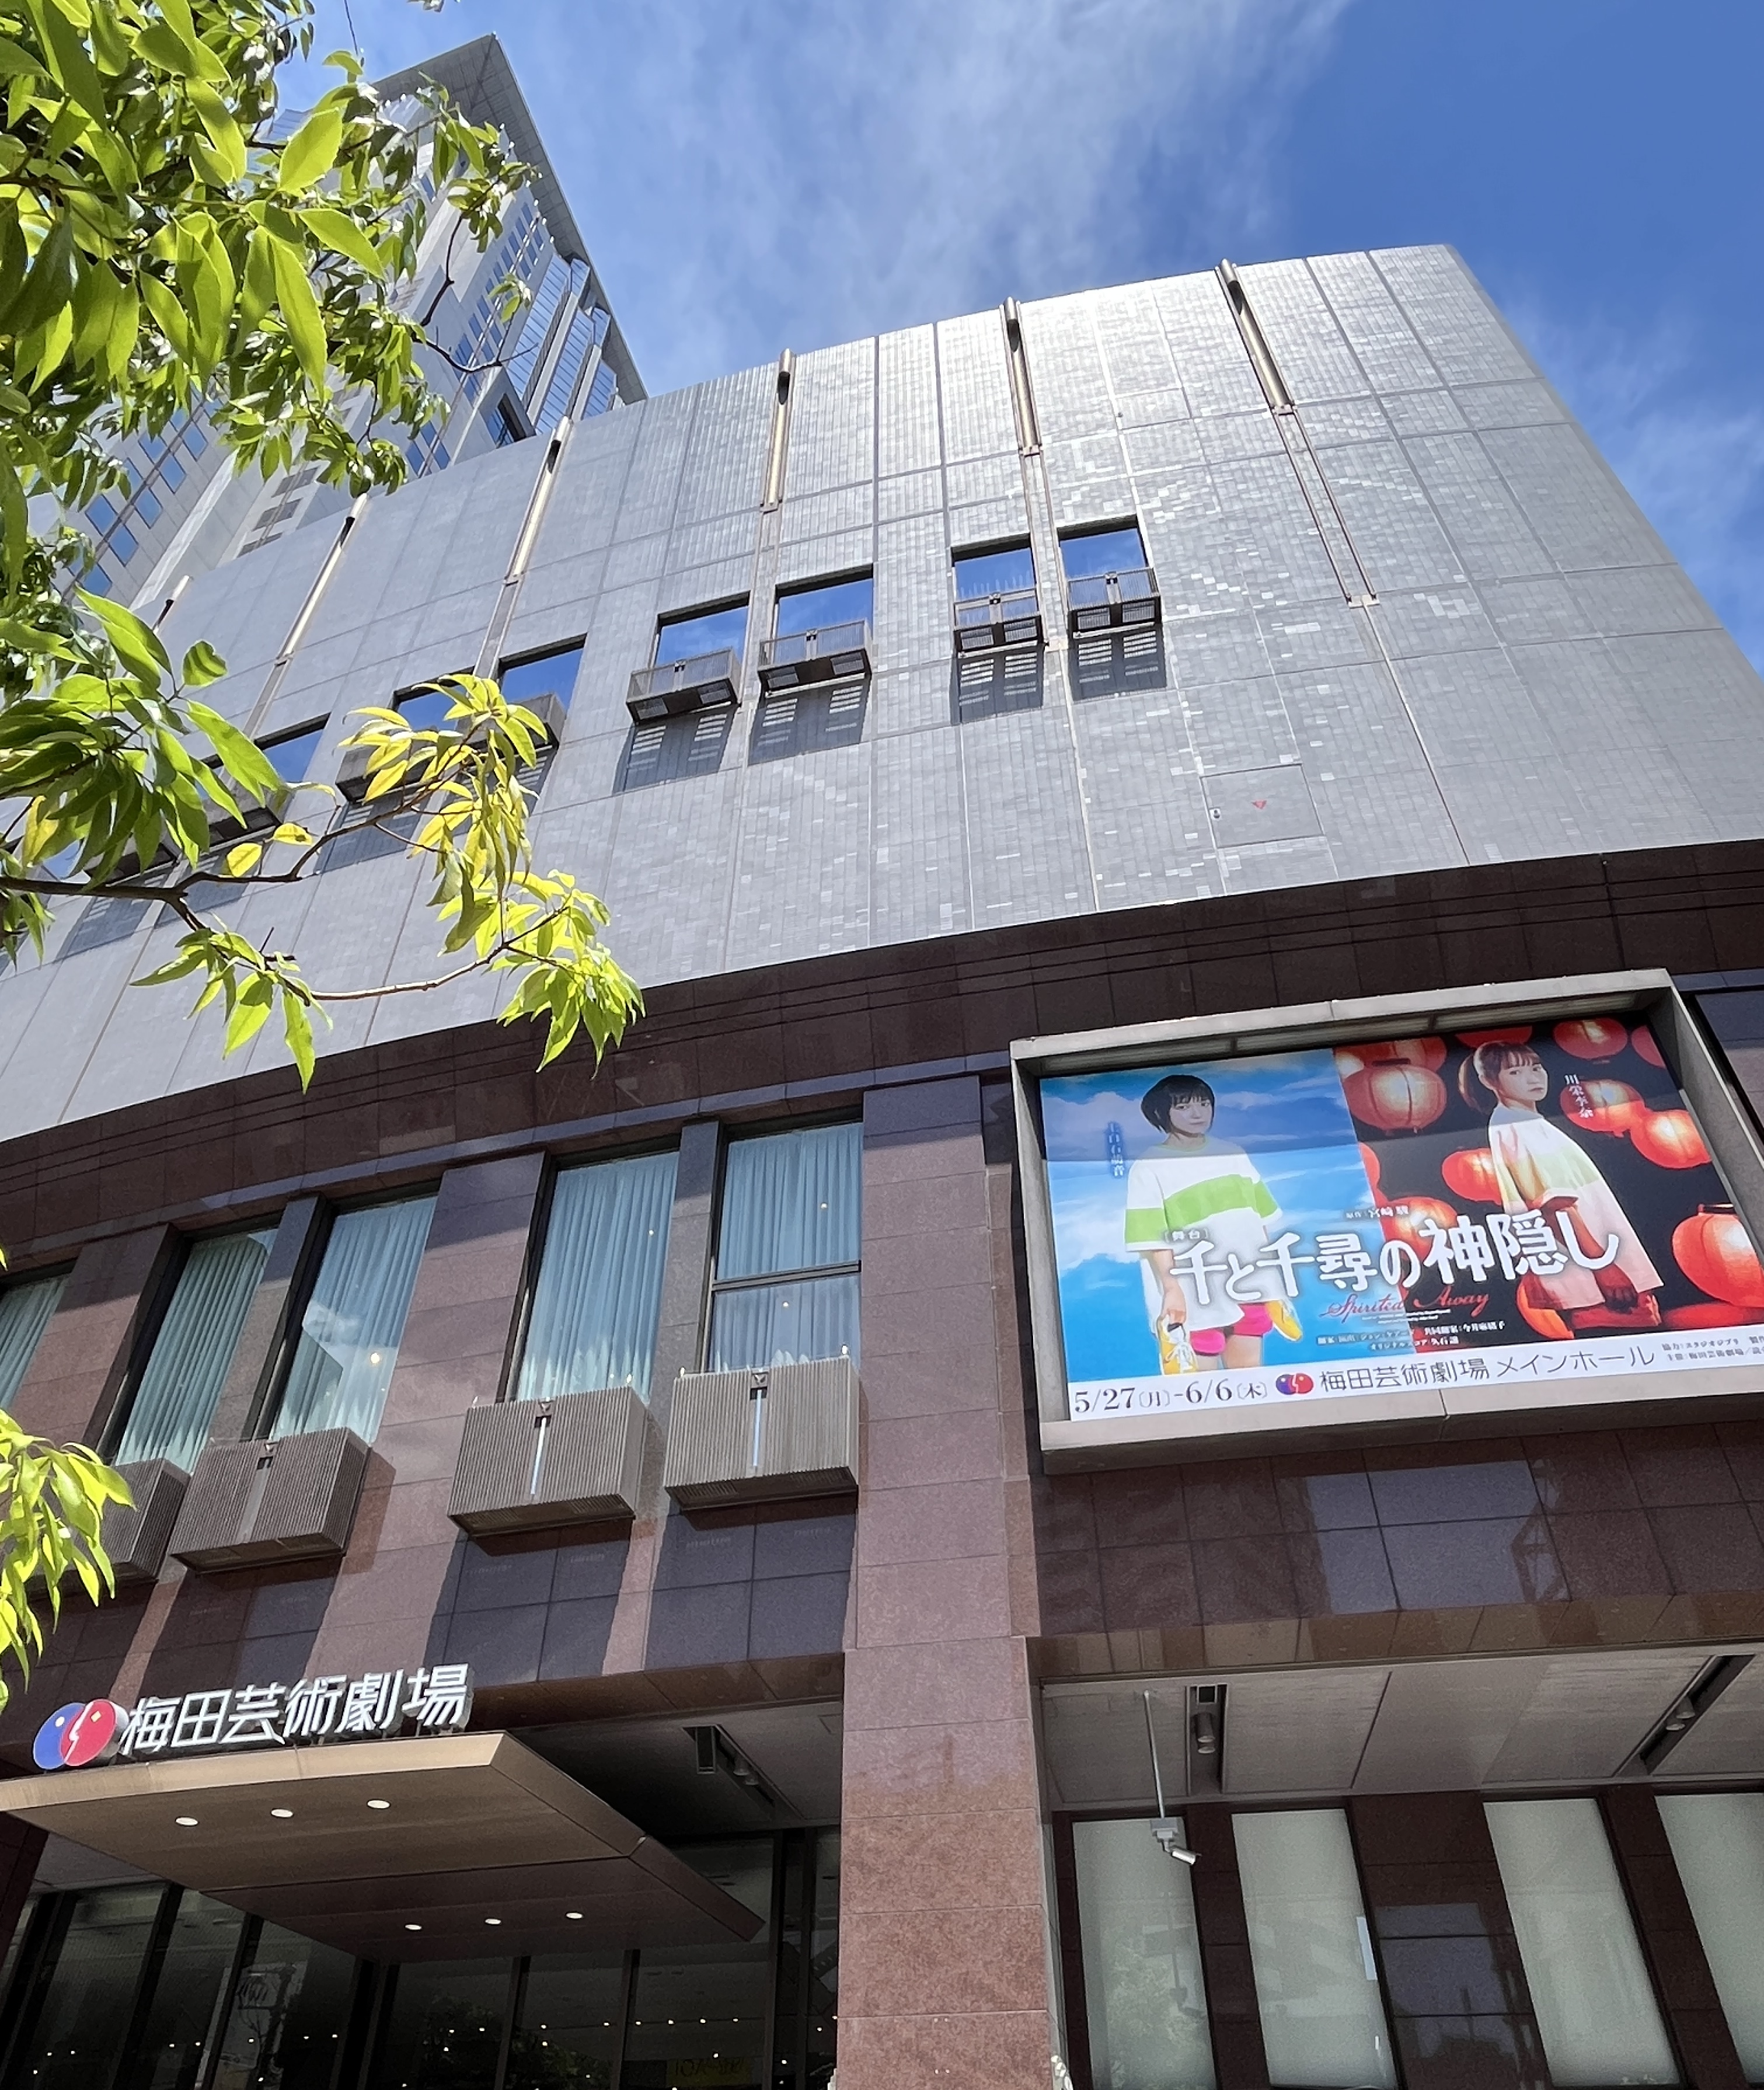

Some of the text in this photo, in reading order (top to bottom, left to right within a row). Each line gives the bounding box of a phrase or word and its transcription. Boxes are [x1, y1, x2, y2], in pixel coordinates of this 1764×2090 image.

[1170, 1209, 1619, 1304] 千と千尋の神隠し
[1319, 1284, 1490, 1323] Spirited Away
[1320, 1358, 1490, 1392] 梅田芸術劇場
[1496, 1345, 1655, 1377] メインホール
[119, 1663, 469, 1755] 梅田芸術劇場
